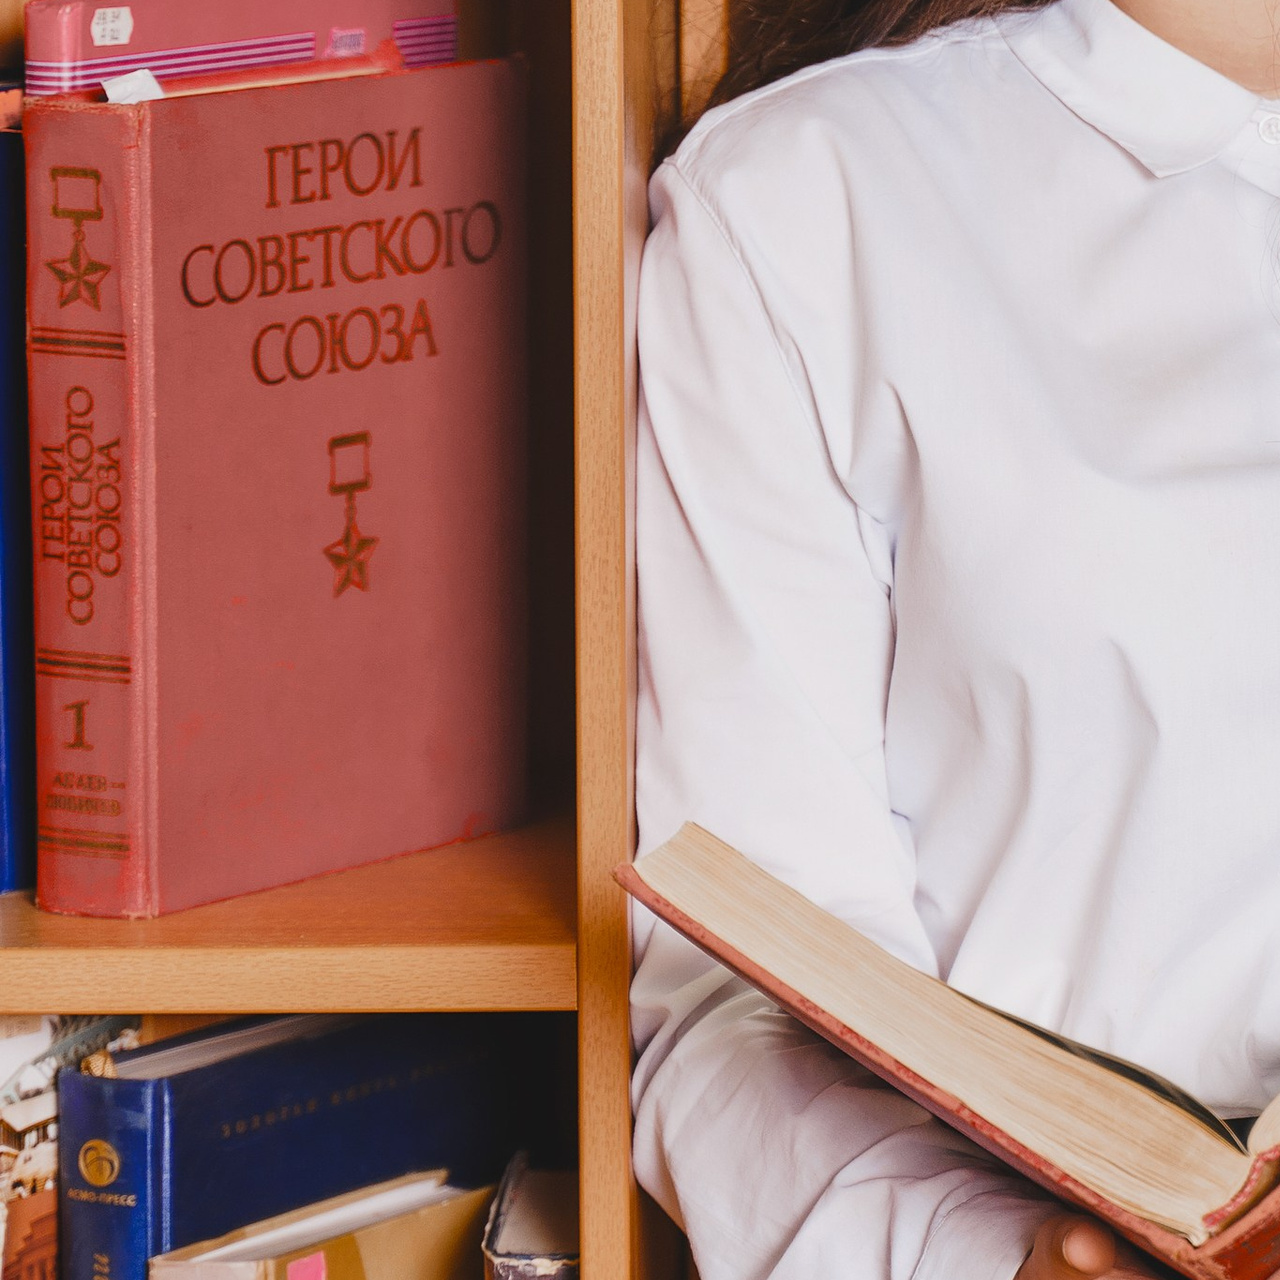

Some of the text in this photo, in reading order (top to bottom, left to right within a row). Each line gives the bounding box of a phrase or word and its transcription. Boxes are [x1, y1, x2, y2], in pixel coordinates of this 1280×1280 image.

[265, 127, 424, 209] ГЕРОИ
[181, 200, 501, 310] СОВЕТСКОГО
[251, 298, 439, 387] СОЮЗА
[41, 443, 66, 563] ГЕРОИ
[65, 385, 96, 626] СОВЕТСКОГО
[95, 436, 122, 579] СОЮЗА
